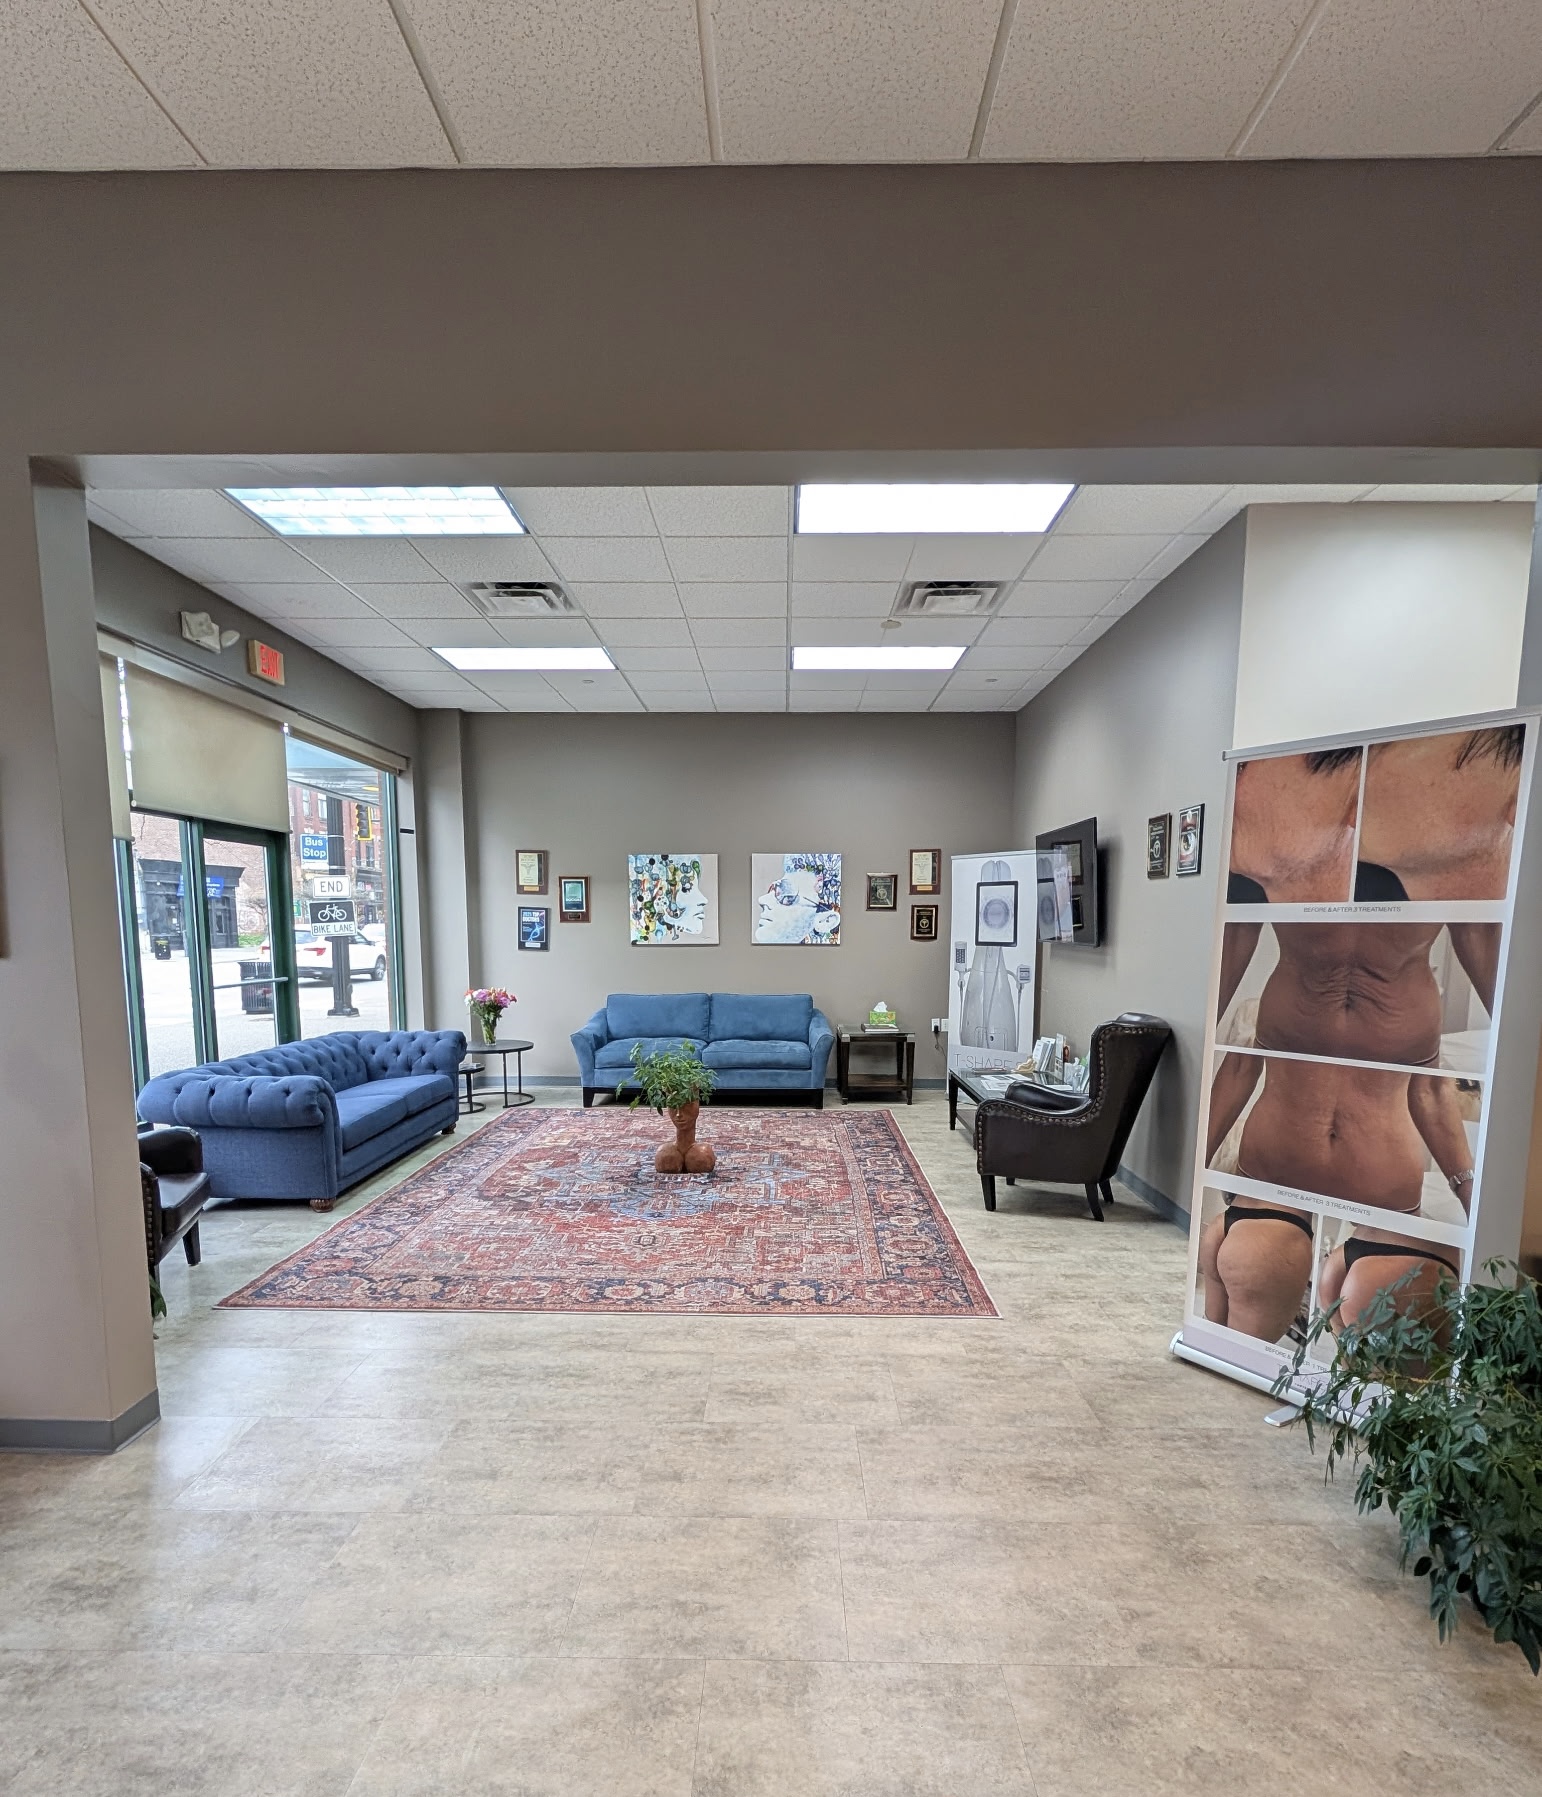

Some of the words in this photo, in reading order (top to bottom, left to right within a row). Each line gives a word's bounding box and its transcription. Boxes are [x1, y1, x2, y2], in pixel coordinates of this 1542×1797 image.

[305, 837, 323, 847] Bus
[303, 848, 327, 859] Stop
[320, 881, 343, 893] END
[313, 924, 331, 934] BIKE
[333, 923, 354, 933] LANE
[1304, 1196, 1324, 1205] AFTER
[1330, 1202, 1371, 1216] TREATMENTS
